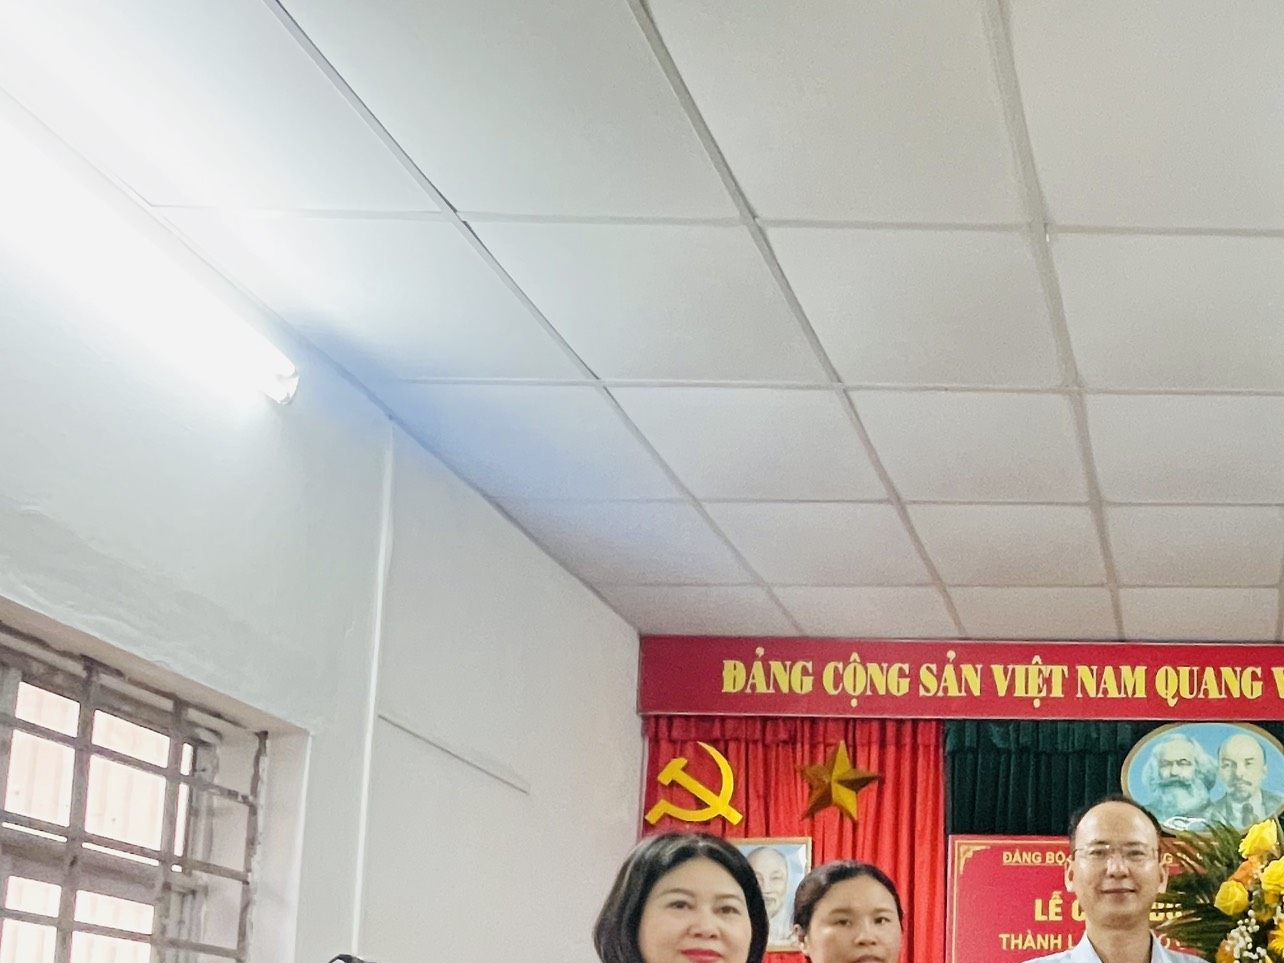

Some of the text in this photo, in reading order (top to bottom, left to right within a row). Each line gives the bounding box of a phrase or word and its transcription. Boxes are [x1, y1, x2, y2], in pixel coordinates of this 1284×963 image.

[722, 646, 814, 694] ĐẢNG
[822, 652, 911, 708] CỘNG
[919, 650, 983, 697] SẢN
[991, 655, 1068, 708] VIỆT
[1076, 664, 1147, 698] NAM
[1155, 665, 1263, 707] QUANG
[1002, 850, 1042, 864] ĐẢNG
[1034, 891, 1063, 921] LỄ
[999, 930, 1062, 950] THÀNH
